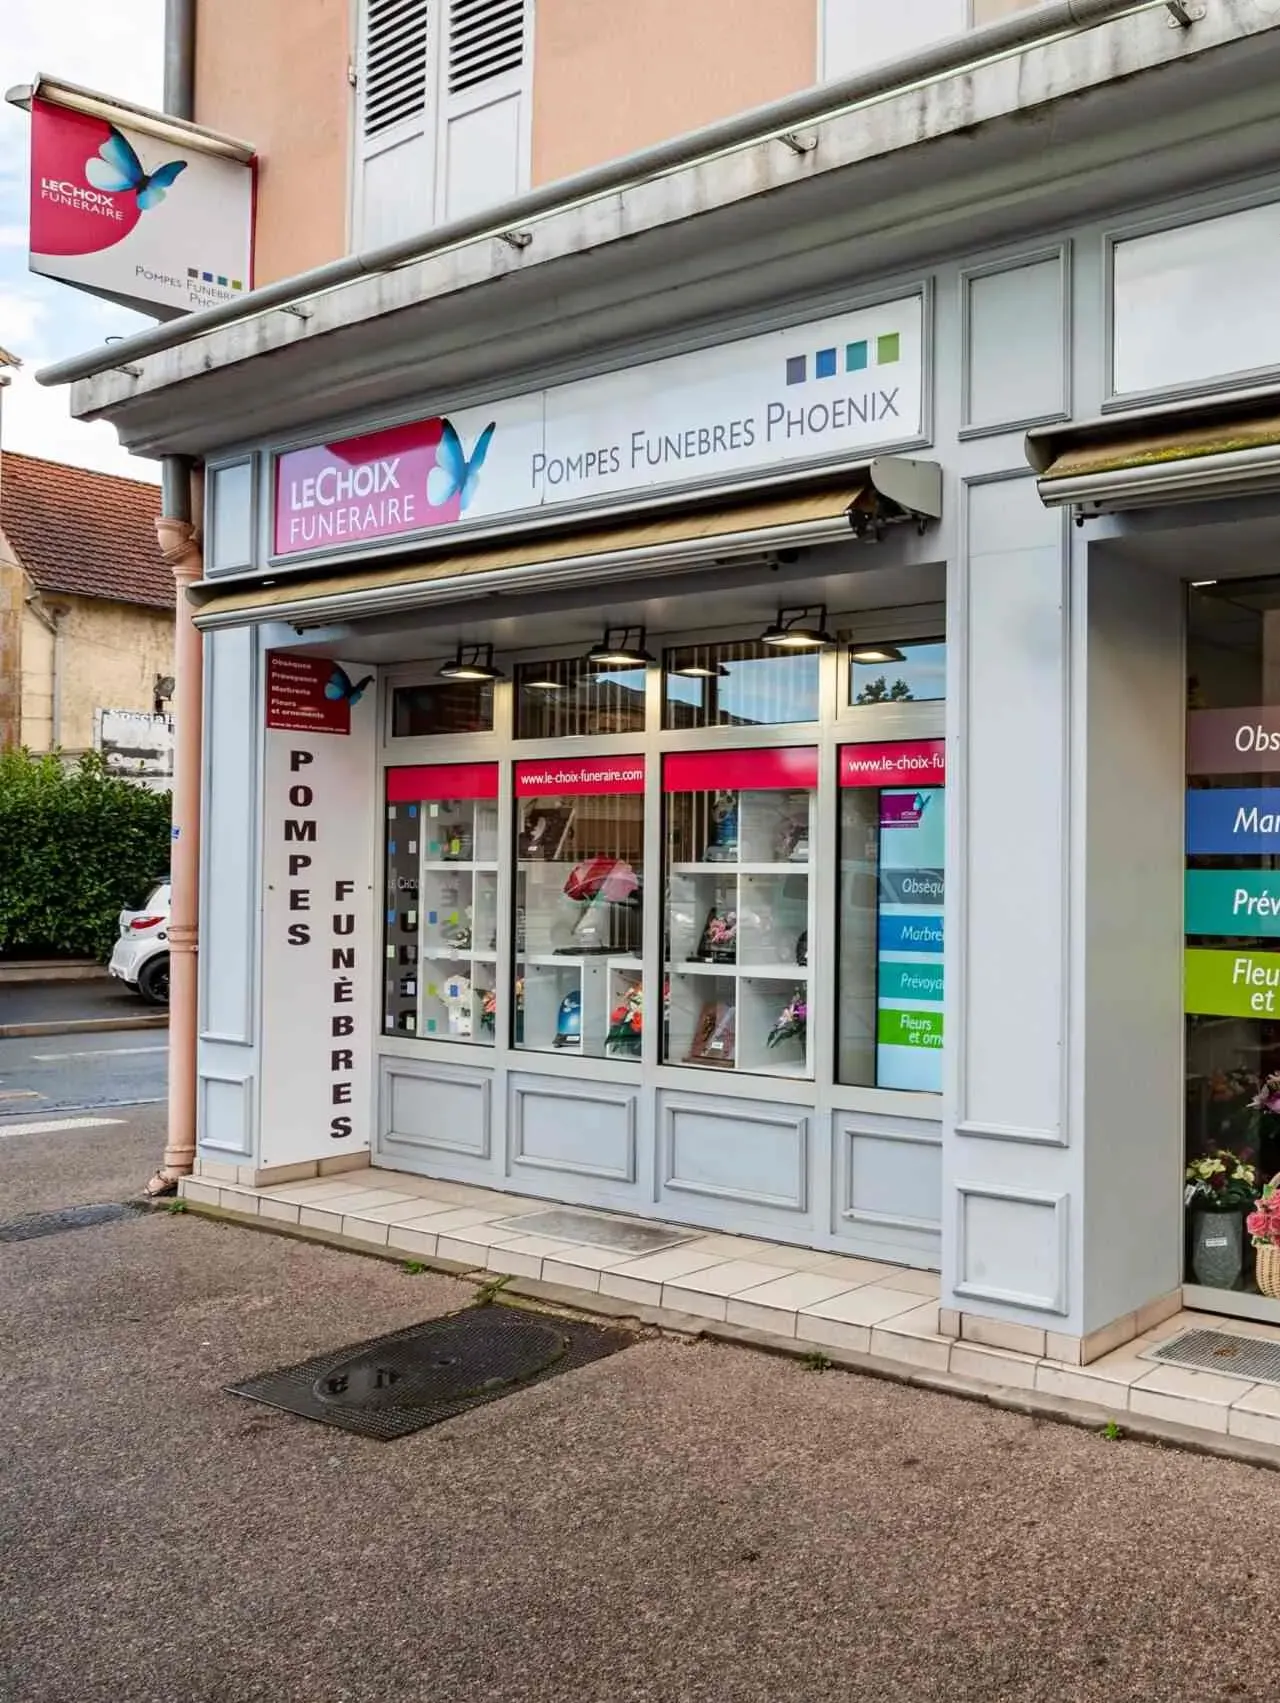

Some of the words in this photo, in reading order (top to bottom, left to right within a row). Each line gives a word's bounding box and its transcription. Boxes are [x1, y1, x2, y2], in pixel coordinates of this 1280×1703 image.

[186, 280, 237, 300] FUNEBRE
[290, 494, 415, 544] FUNERAIRE
[848, 753, 945, 772] www.le-choix-fu
[283, 750, 317, 946] POMPES
[902, 878, 945, 898] Obsèqu
[901, 925, 945, 942] Marbre
[901, 972, 945, 993] Prévoya
[330, 880, 356, 1139] FUNÈBRES
[1251, 990, 1274, 1013] et
